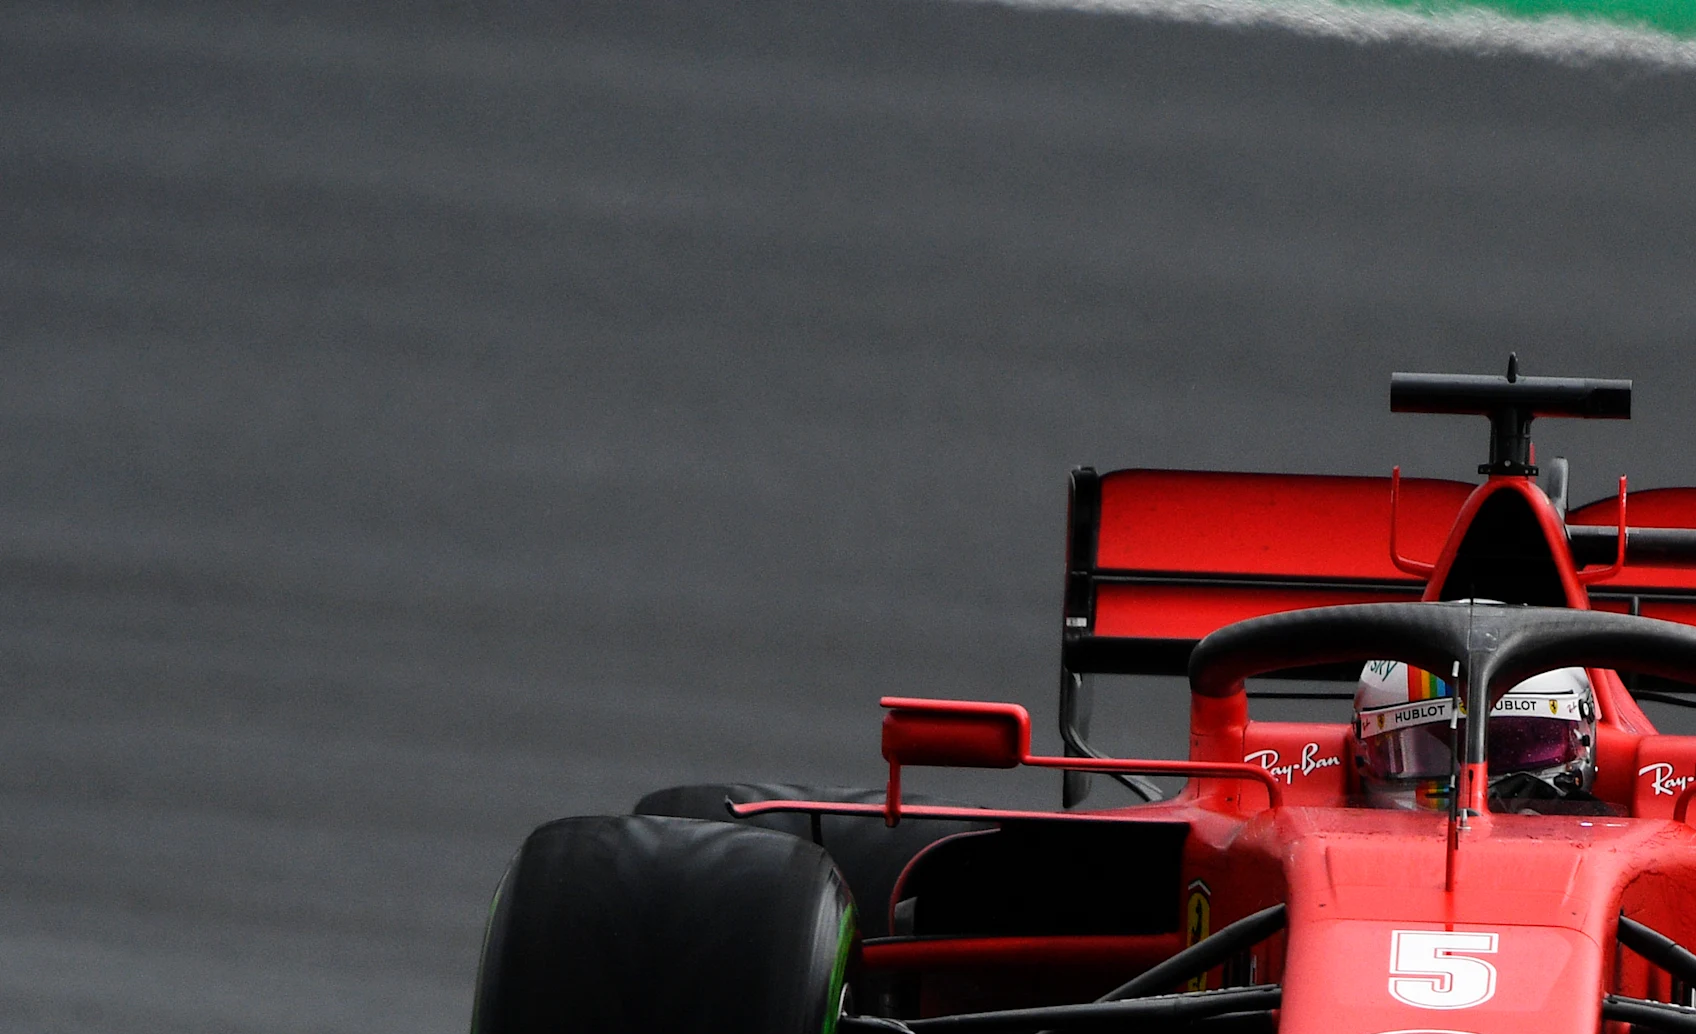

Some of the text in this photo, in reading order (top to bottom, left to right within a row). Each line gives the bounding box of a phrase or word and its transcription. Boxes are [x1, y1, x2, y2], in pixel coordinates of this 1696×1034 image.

[1395, 704, 1446, 723] HUBLOT
[1494, 700, 1537, 711] UBLOT
[1244, 742, 1340, 785] Ray-Ban
[1388, 929, 1499, 1010] 5
